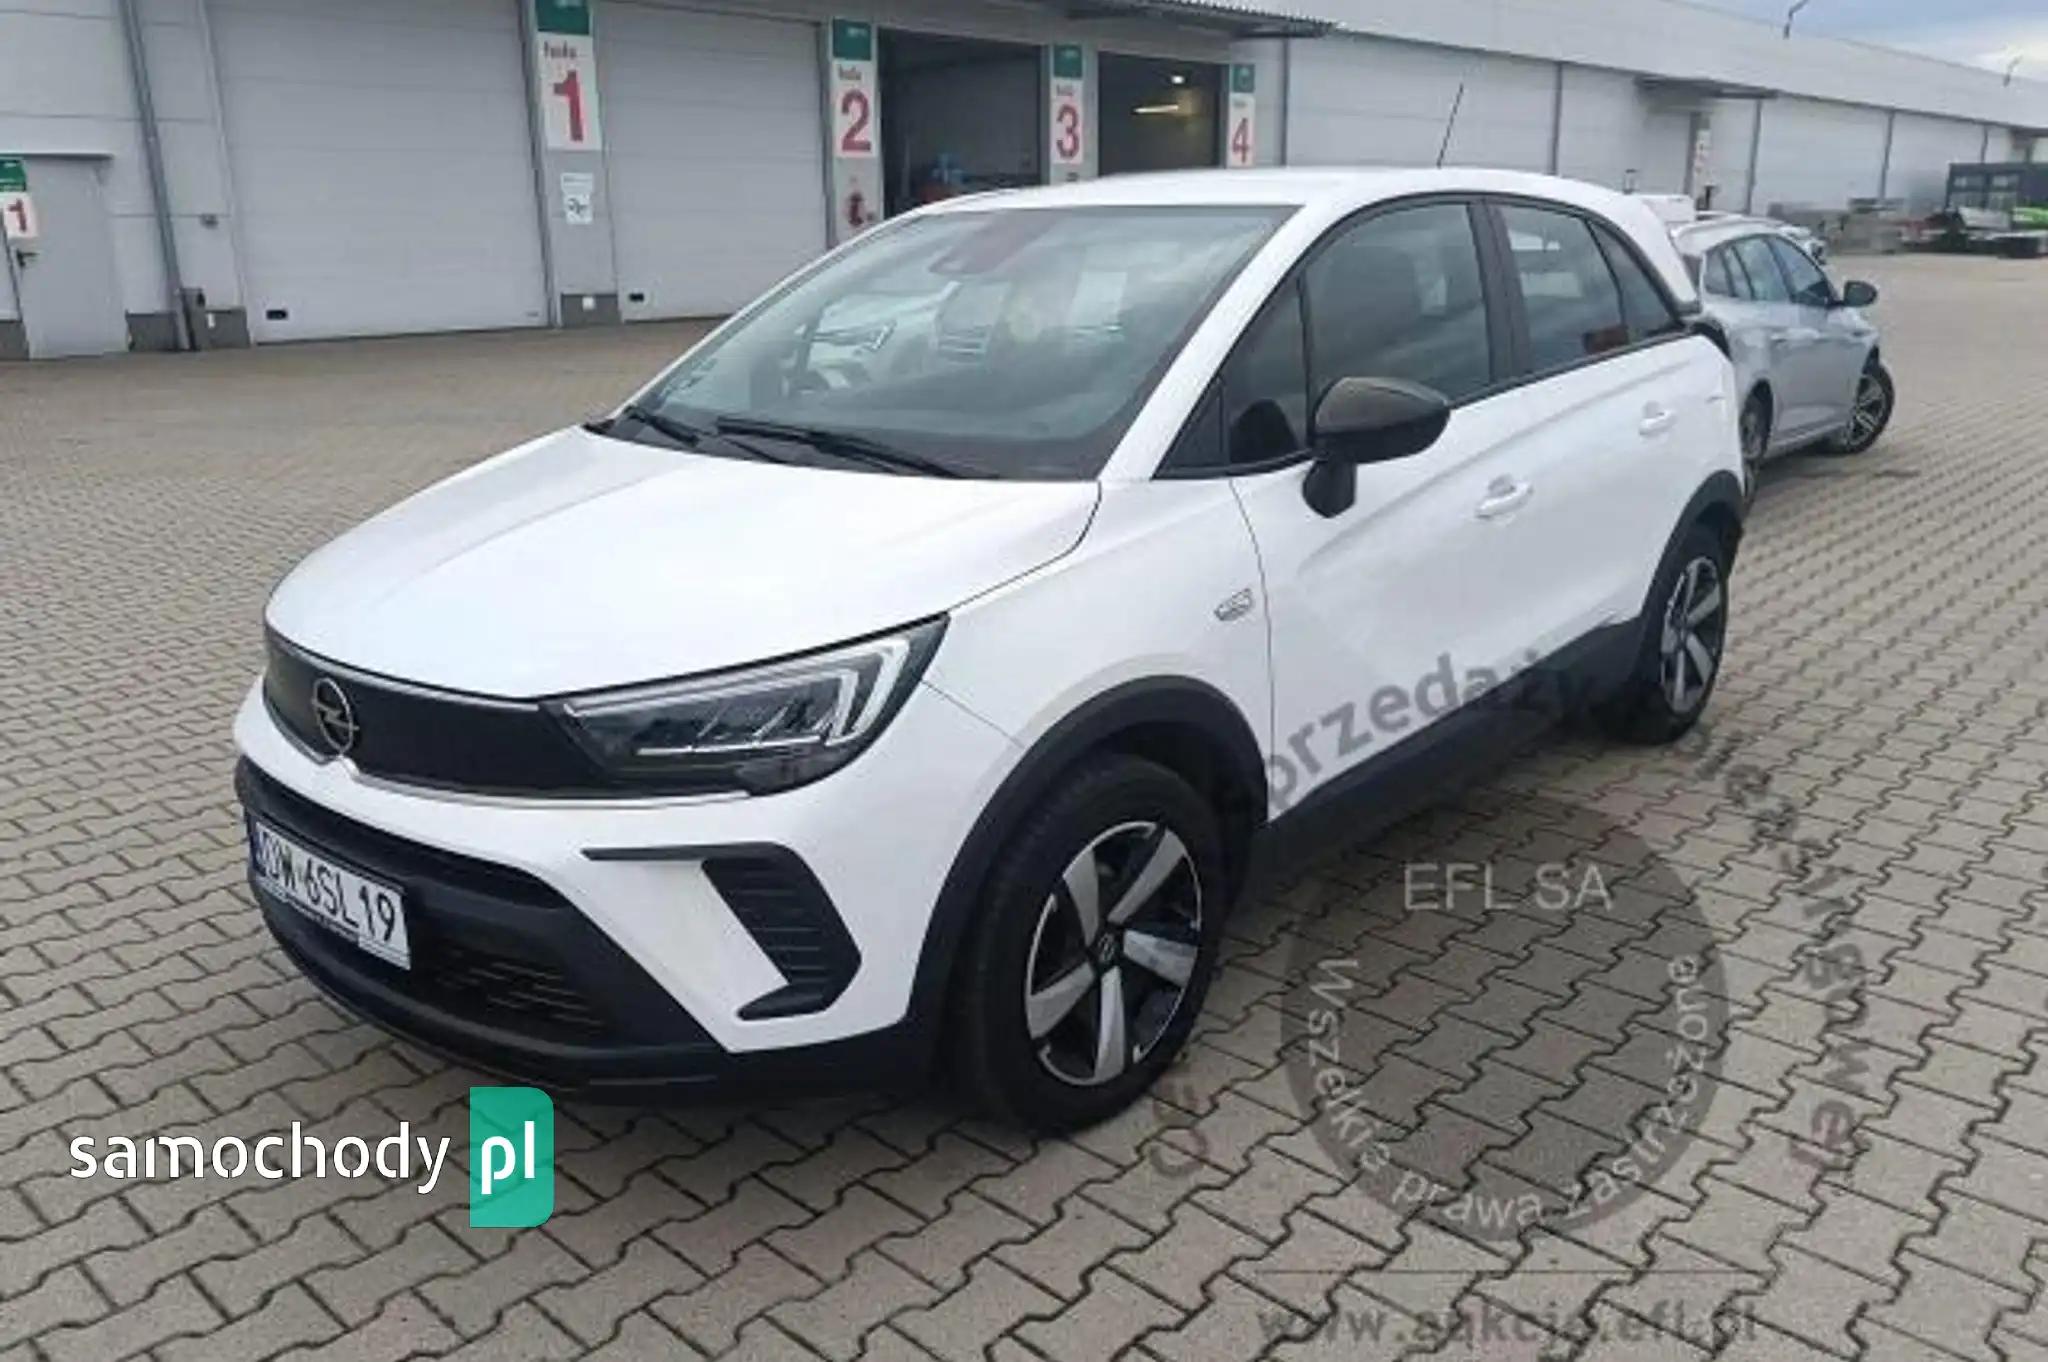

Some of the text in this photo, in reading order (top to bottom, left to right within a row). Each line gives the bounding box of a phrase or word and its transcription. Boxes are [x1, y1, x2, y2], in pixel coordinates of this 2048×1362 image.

[553, 69, 583, 141] 1
[841, 89, 872, 151] 2
[1056, 104, 1079, 159] 3
[1232, 117, 1249, 163] 4
[8, 198, 27, 232] 1
[304, 856, 396, 942] 6SL19
